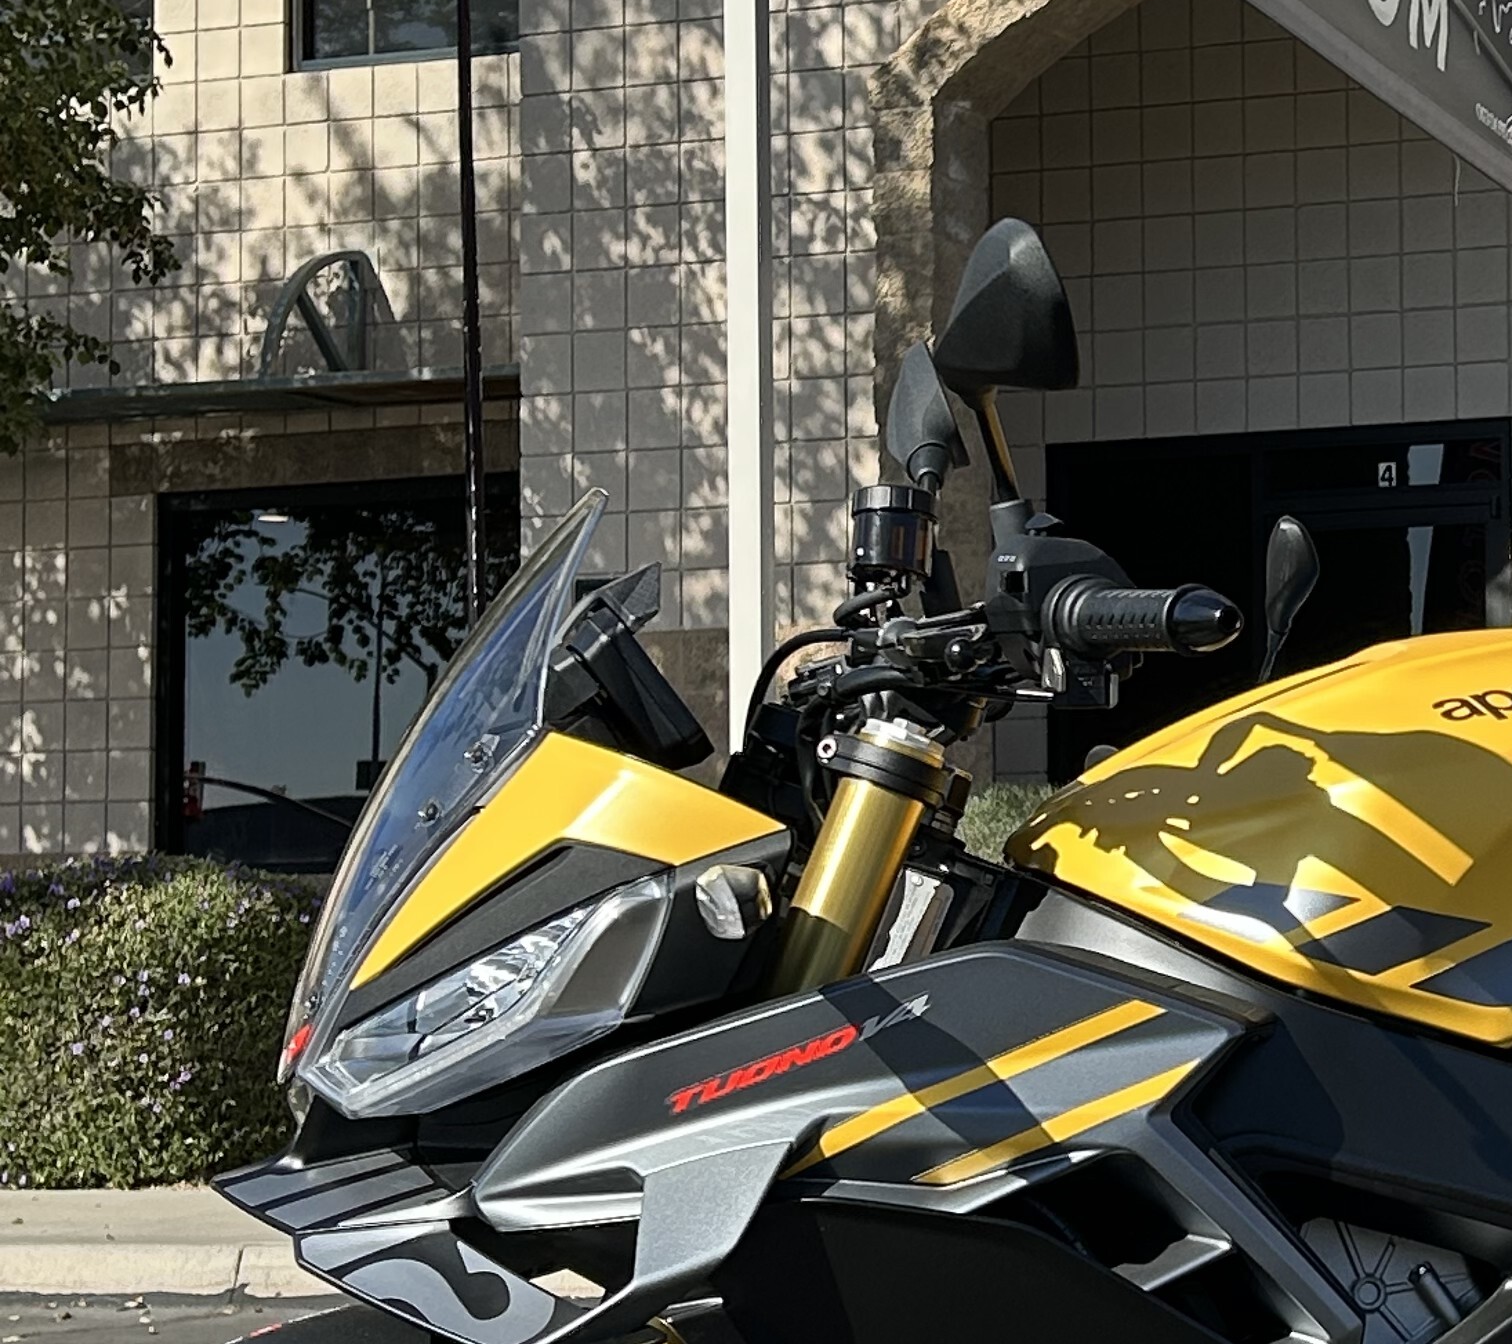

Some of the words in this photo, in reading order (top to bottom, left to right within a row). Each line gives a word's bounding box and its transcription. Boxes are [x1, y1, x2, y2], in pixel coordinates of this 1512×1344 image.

[1380, 464, 1395, 488] 4
[666, 1023, 857, 1114] TUONO
[859, 992, 931, 1042] V4
